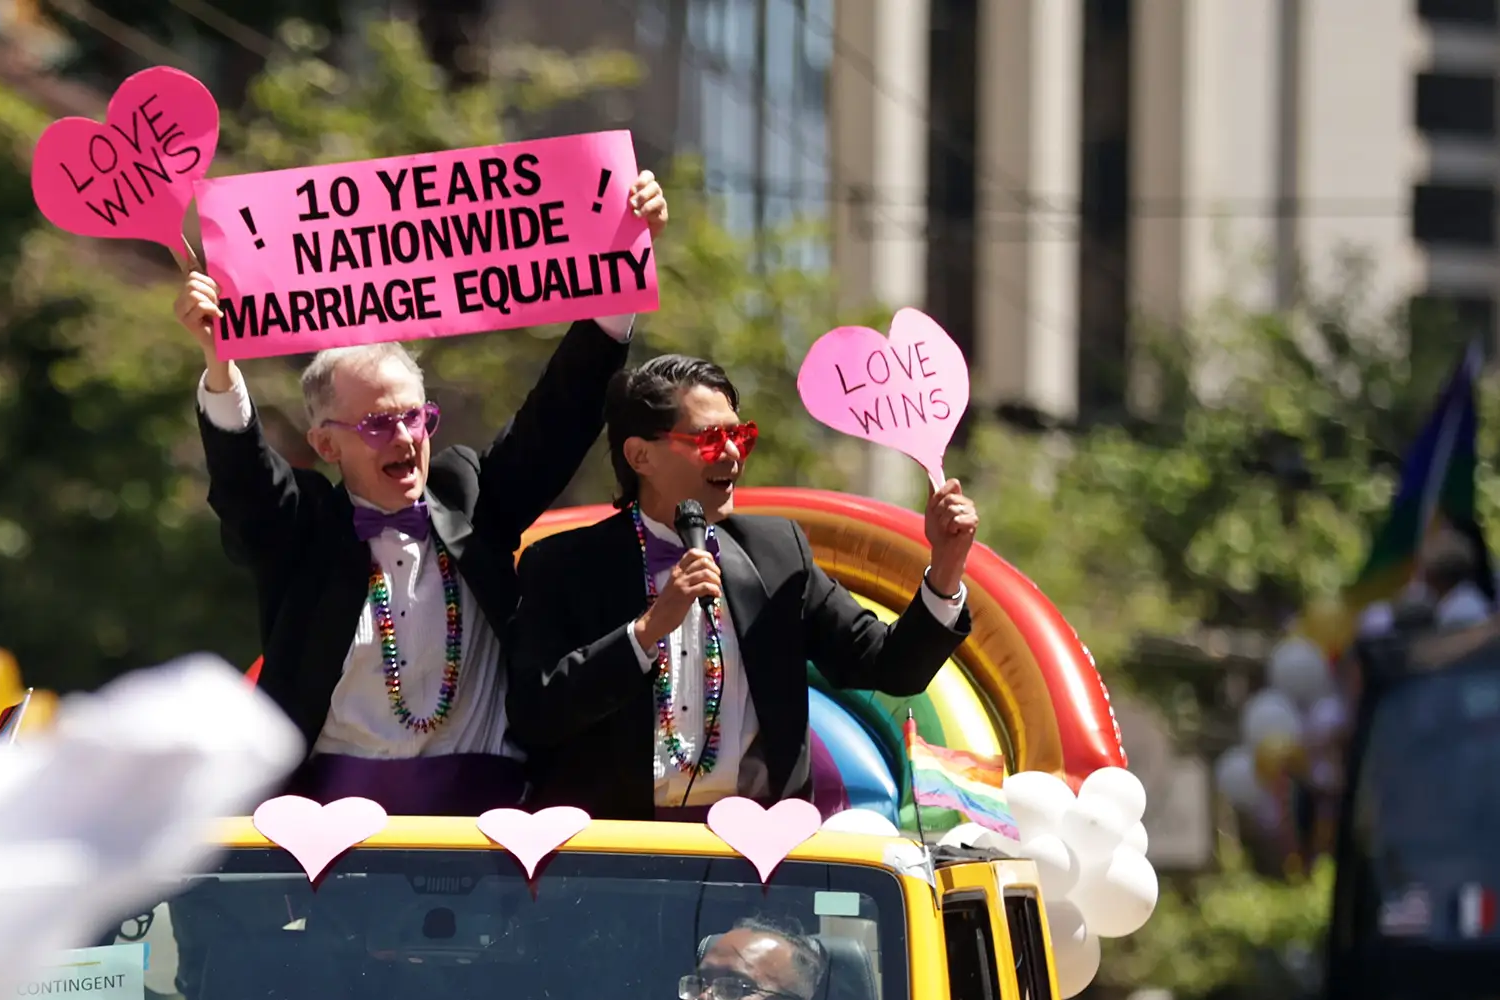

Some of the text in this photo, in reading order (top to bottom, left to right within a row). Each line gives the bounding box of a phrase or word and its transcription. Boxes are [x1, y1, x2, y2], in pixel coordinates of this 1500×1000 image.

[59, 94, 173, 194] LOVE
[86, 132, 201, 228] WINS
[239, 152, 612, 250] ! 10 YEARS !
[293, 201, 570, 275] NATIONWIDE
[219, 247, 651, 340] MARRIAGE EQUALITY
[835, 341, 936, 395] LOVE
[849, 388, 950, 434] WINS
